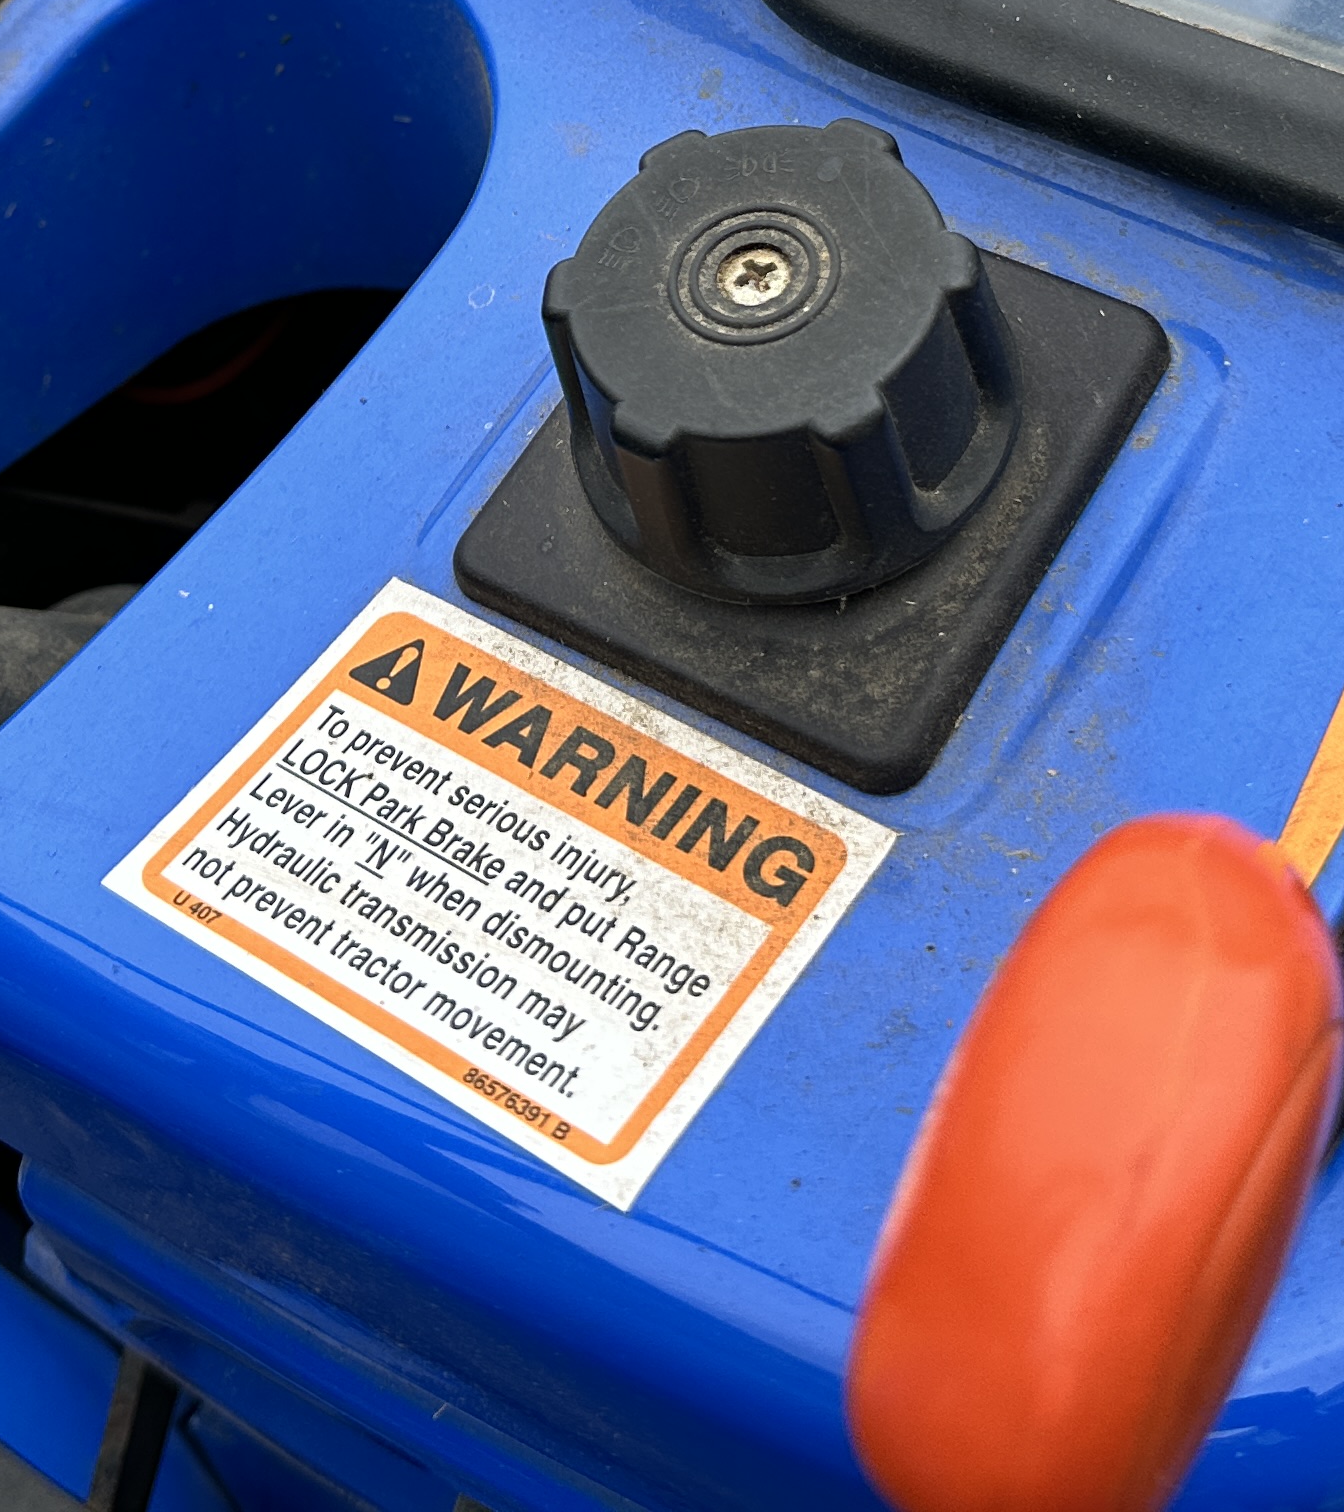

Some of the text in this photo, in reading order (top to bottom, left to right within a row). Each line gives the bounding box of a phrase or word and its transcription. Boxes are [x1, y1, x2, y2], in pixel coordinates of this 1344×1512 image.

[249, 772, 663, 1032] Lever in "N" when dismounting.
[280, 738, 712, 998] LOCK Park Brake and put Range
[317, 704, 637, 907] To prevent serious injury,
[432, 662, 816, 909] WARNING
[172, 889, 223, 924] U 407
[182, 846, 582, 1099] not prevent tractor movement.
[216, 806, 587, 1042] Hydraulic transmission may
[462, 1067, 572, 1141] 86576391 B
